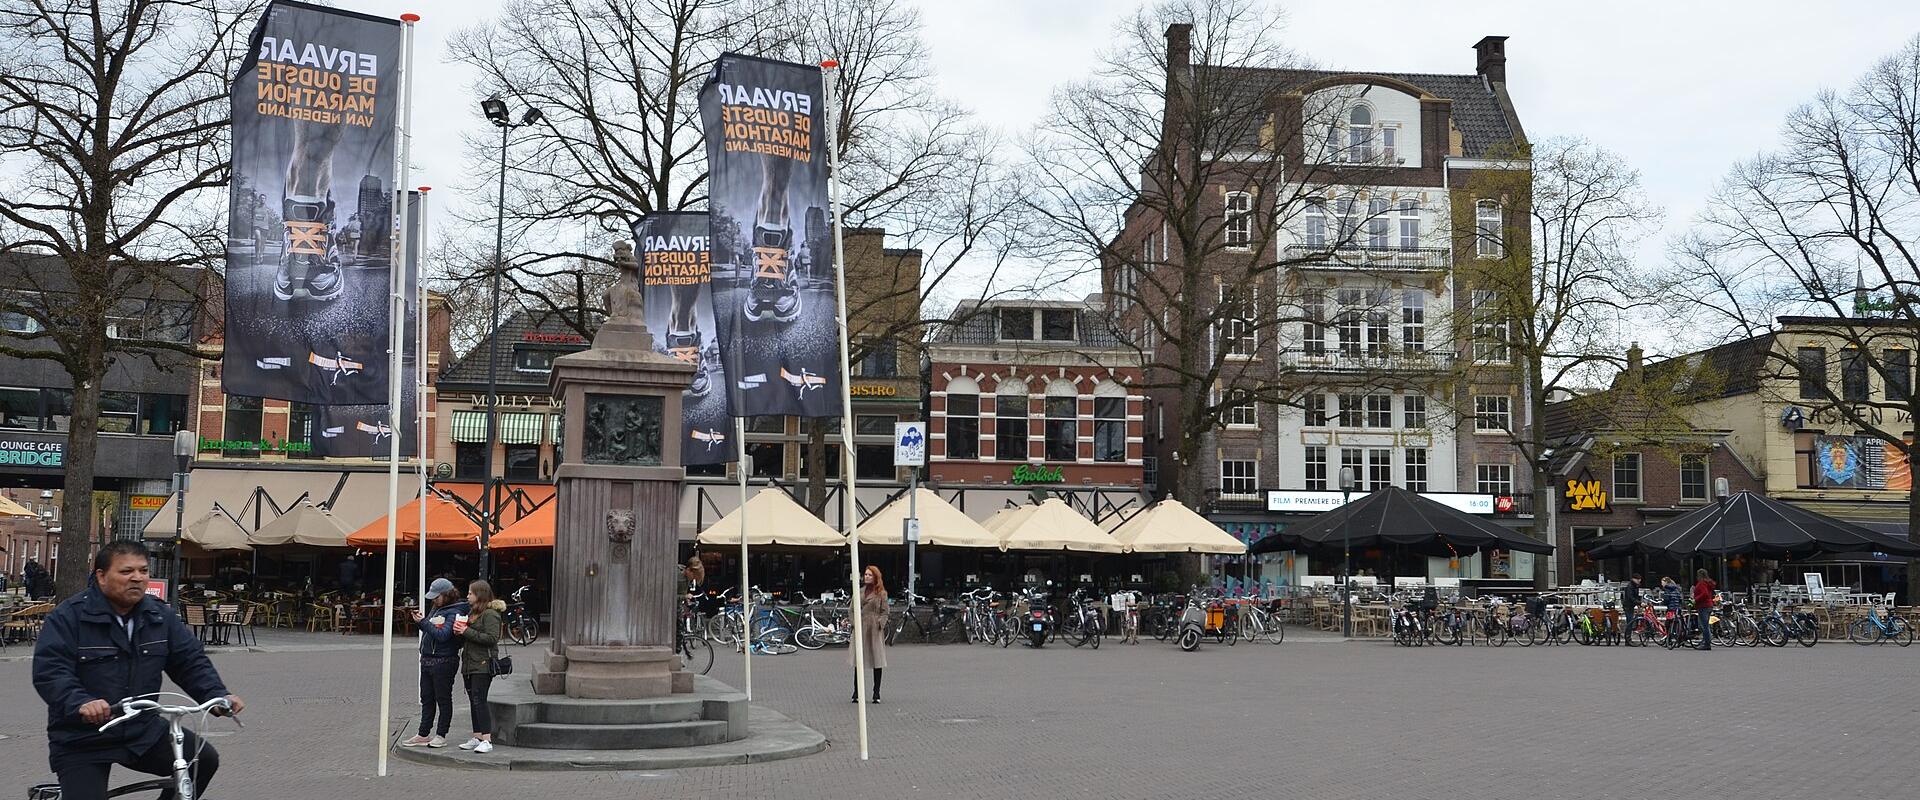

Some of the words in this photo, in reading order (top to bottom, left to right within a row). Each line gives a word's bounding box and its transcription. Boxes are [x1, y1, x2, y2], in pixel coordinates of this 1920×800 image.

[850, 384, 896, 396] BISTRO
[471, 394, 535, 408] MOLLY
[0, 441, 36, 450] OUNGE
[38, 442, 62, 452] CAFE
[0, 450, 62, 466] BRIDGE
[1013, 464, 1064, 485] Grolsch
[1566, 480, 1600, 497] SAM
[1295, 497, 1329, 505] PREMIERE
[1498, 498, 1512, 510] illy
[1571, 491, 1606, 510] SAM
